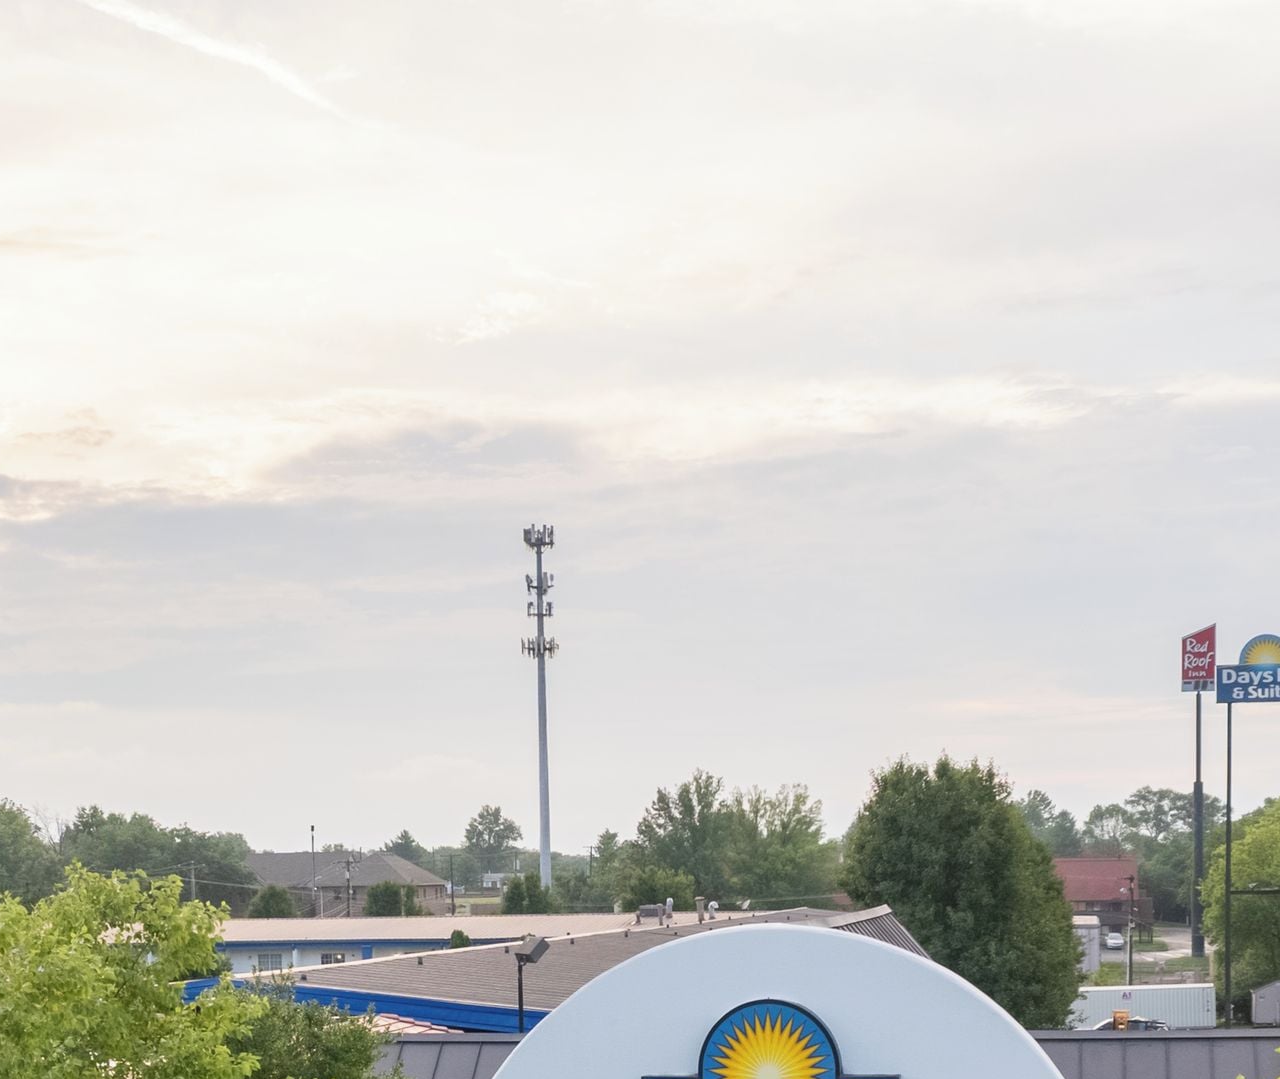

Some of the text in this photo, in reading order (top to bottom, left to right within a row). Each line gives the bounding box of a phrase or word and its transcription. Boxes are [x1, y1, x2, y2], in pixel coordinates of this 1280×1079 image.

[1186, 638, 1209, 652] Red
[1184, 652, 1214, 670] Roof
[1222, 669, 1274, 685] Days
[1232, 687, 1245, 699] &
